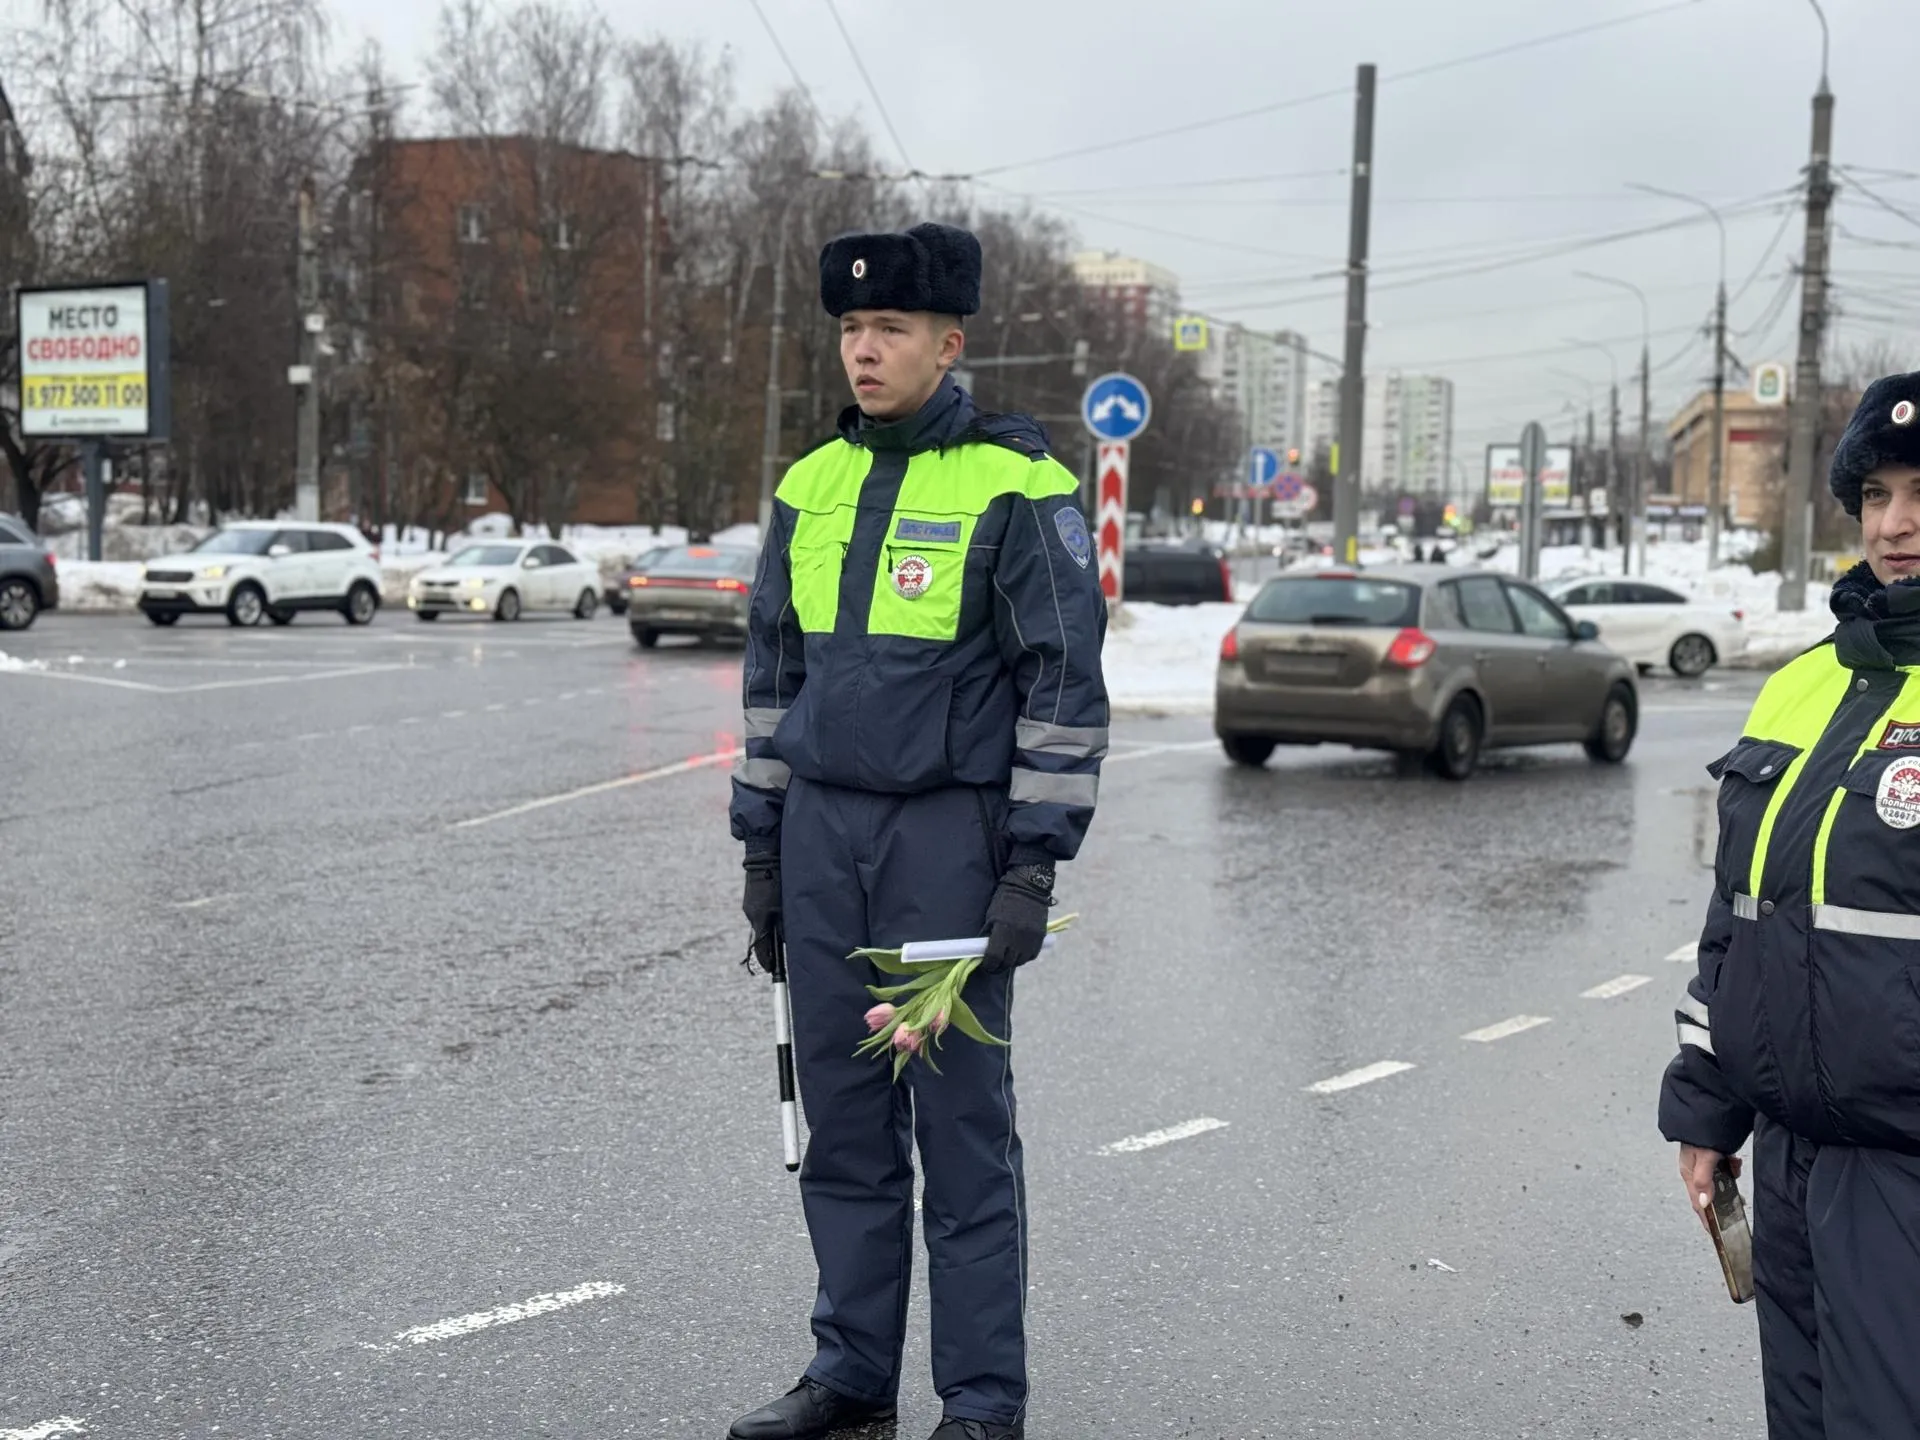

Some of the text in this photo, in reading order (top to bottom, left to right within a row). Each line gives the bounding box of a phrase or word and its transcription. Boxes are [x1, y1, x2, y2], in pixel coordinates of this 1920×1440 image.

[49, 305, 118, 329] МЕСТО
[27, 335, 141, 360] СВОБОДНО
[40, 385, 66, 406] 977
[71, 384, 99, 405] 500
[104, 385, 118, 405] 11
[122, 383, 143, 403] 00
[1885, 728, 1920, 745] ДПС
